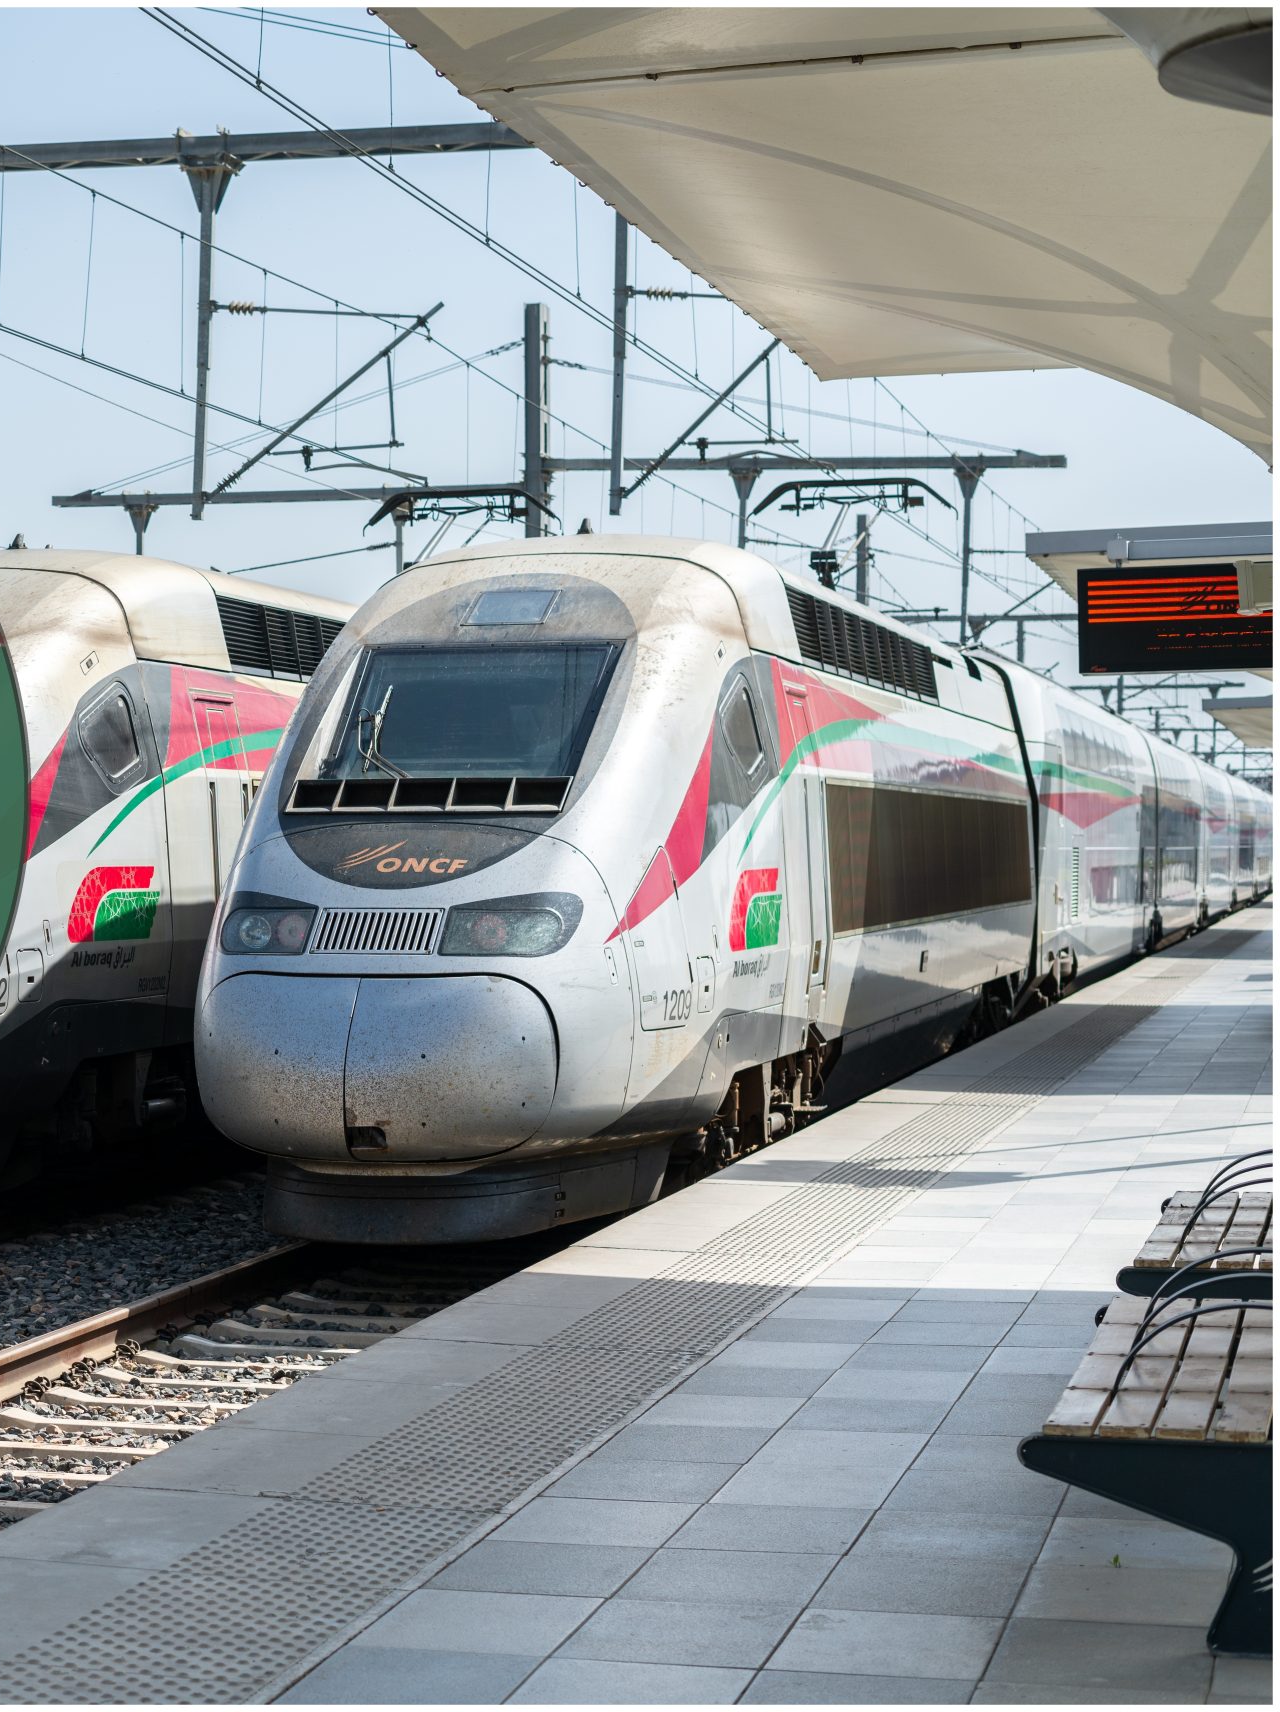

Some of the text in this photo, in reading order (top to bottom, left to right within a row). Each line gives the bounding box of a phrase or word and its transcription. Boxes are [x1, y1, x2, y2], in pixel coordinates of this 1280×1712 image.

[376, 857, 468, 874] ONCF
[70, 950, 113, 969] Al boraq
[732, 959, 758, 978] Al boraq
[662, 989, 692, 1021] 1209
